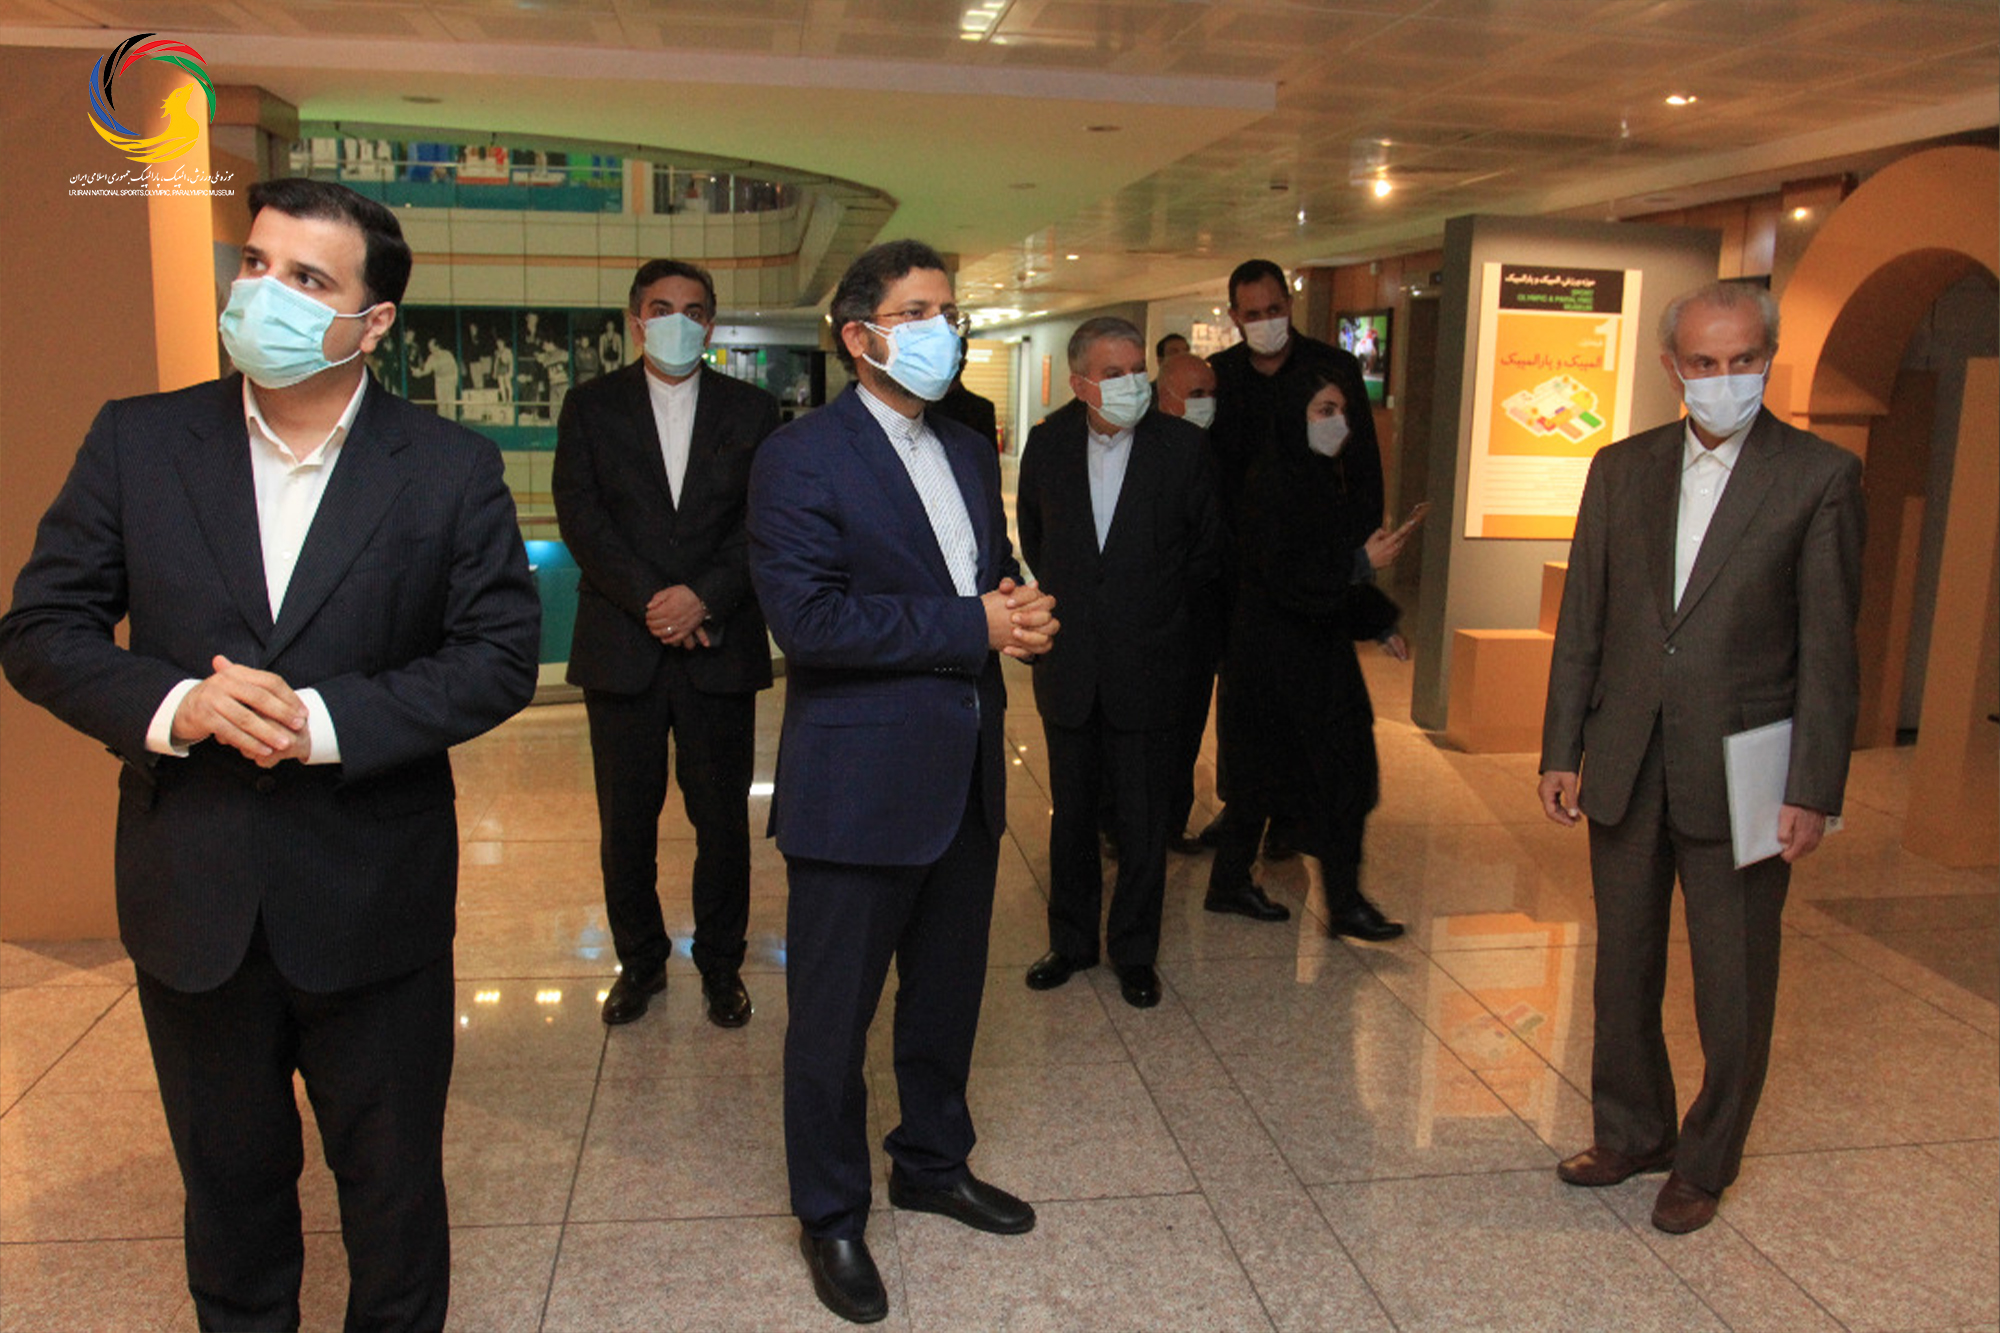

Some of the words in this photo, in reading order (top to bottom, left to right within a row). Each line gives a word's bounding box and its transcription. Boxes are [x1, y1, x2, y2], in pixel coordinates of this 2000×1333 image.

[1594, 317, 1618, 371] 1
[1500, 352, 1553, 371] پارالمپیک
[1563, 355, 1603, 372] المپیک
